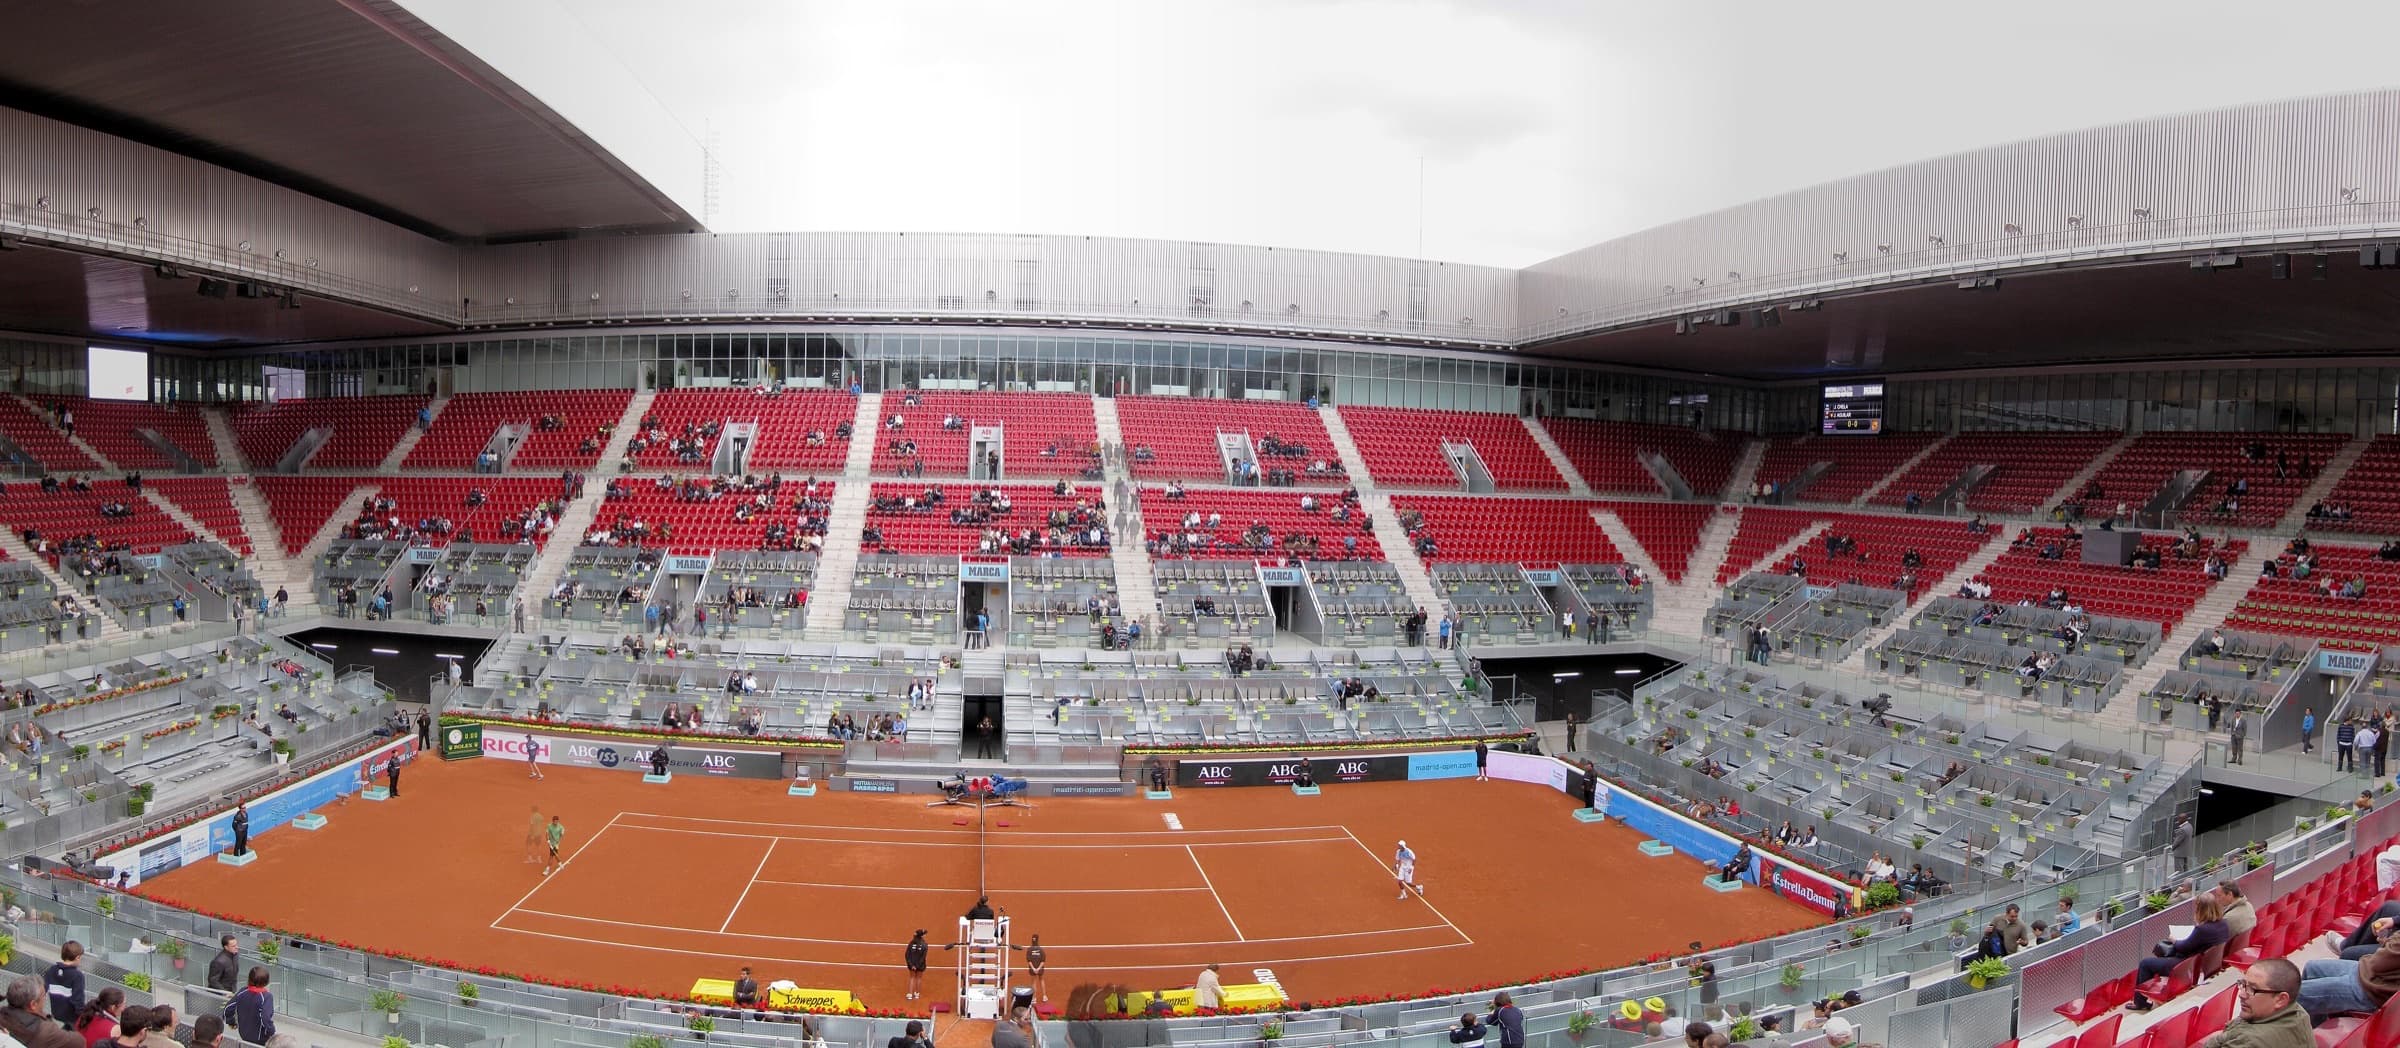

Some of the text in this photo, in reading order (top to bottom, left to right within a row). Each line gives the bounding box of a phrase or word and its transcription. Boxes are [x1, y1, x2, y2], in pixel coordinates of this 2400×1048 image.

[676, 559, 707, 569] MARCA
[968, 566, 1001, 577] MARCA
[1263, 571, 1294, 581] MARCA
[2328, 655, 2367, 671] MARCA
[567, 745, 598, 758] ABC
[701, 754, 736, 768] ABC
[1415, 762, 1473, 772] madrid-open.com
[1198, 766, 1232, 778] ABC
[1268, 764, 1301, 776] ABC
[1336, 761, 1368, 774] ABC
[1772, 872, 1836, 911] Estrella Damm
[784, 995, 836, 1007] Schweppes
